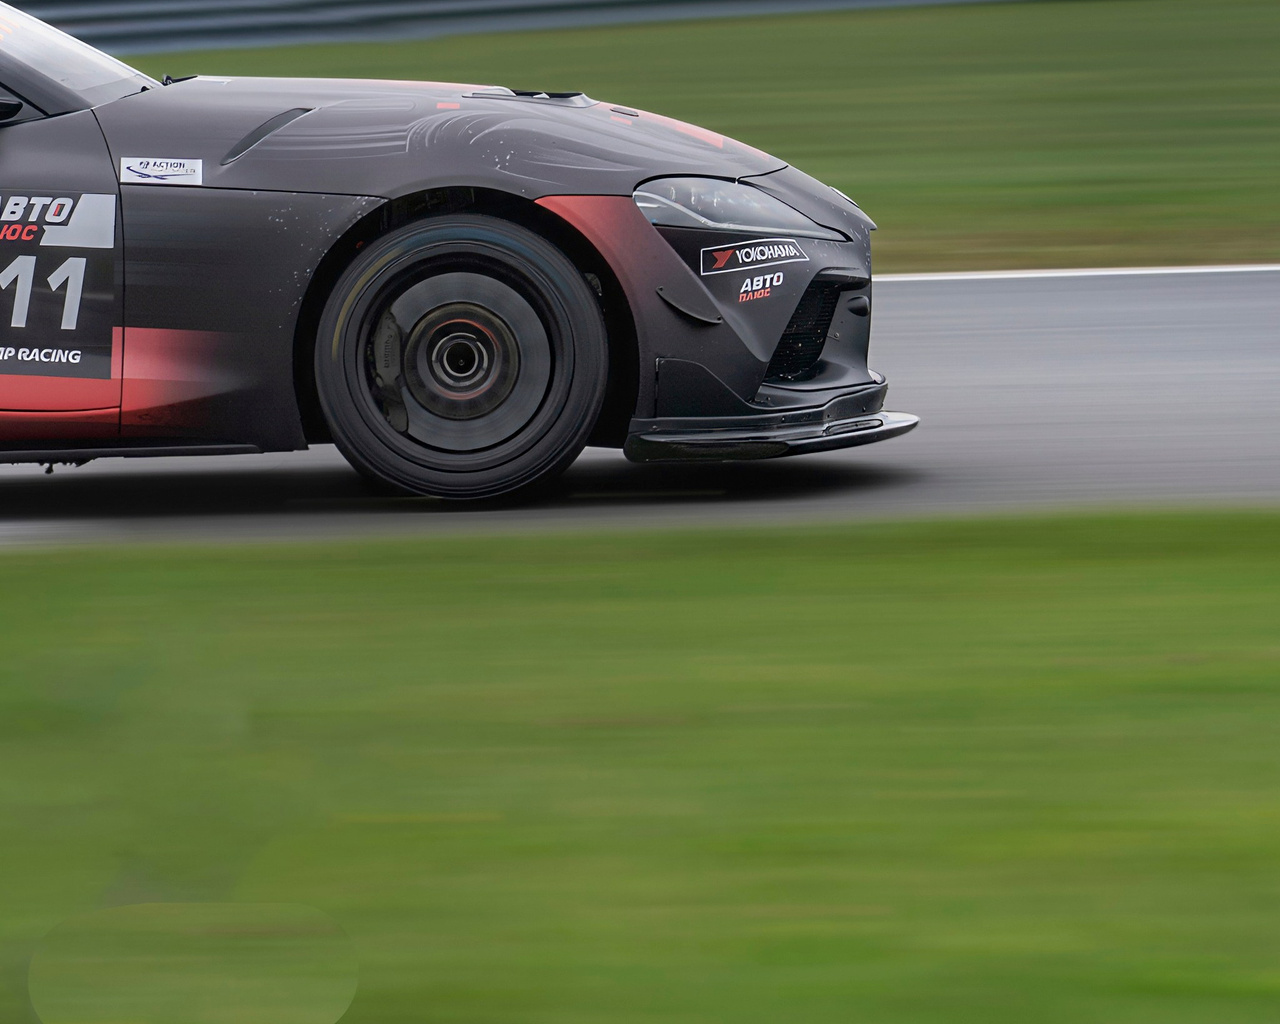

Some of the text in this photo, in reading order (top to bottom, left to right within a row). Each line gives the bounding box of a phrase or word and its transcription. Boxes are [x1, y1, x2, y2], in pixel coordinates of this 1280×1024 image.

[735, 244, 800, 264] YOKOHAMA
[739, 272, 784, 293] АВТО
[738, 287, 771, 303] ПЛЮС
[17, 347, 82, 364] RACING
